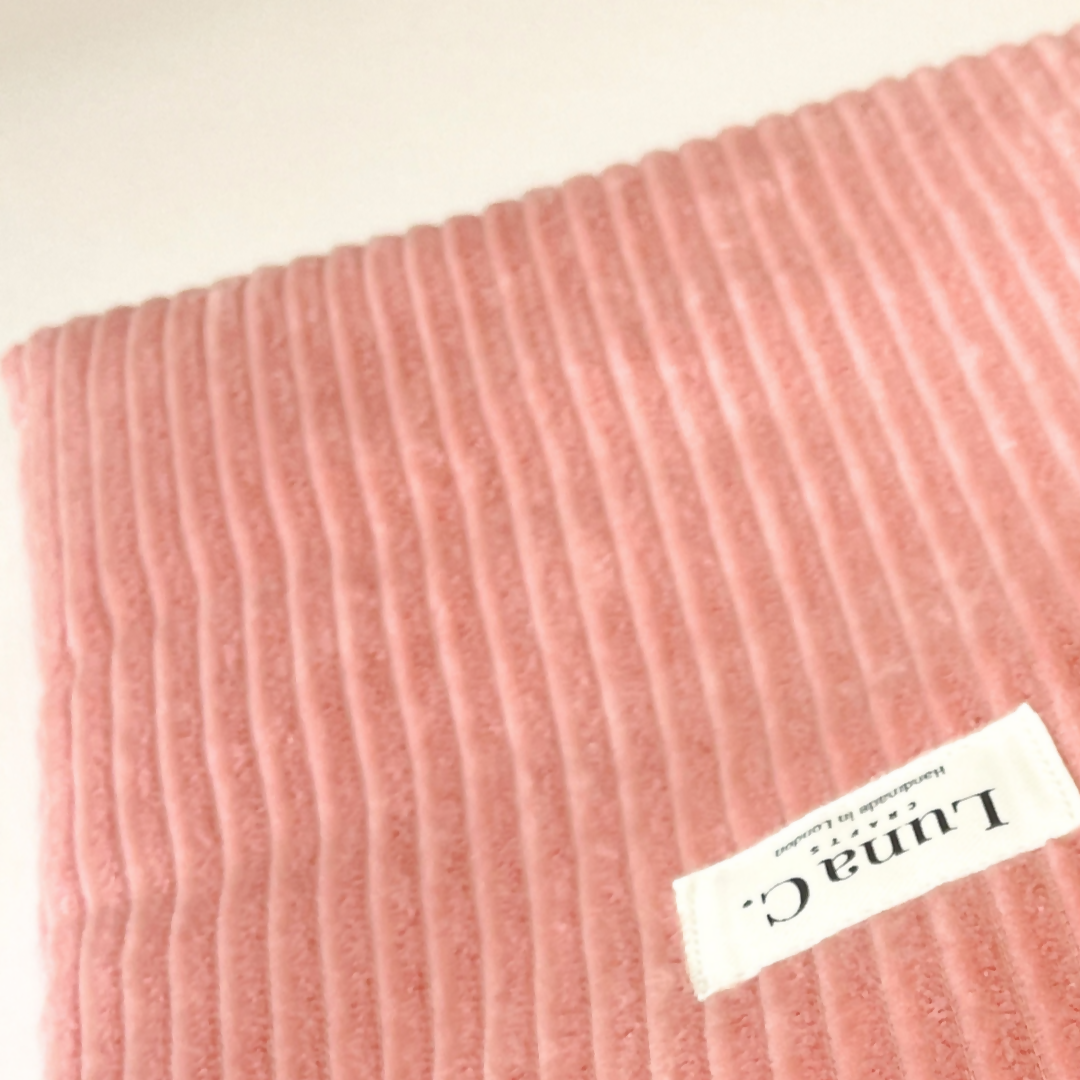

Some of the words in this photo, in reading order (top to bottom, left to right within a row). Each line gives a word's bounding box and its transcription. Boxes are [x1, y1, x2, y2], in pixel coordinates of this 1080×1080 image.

[858, 765, 946, 814] Handmade
[774, 819, 833, 858] London
[809, 800, 918, 856] CRAFTS
[817, 787, 1009, 883] Luna
[837, 811, 854, 824] in
[742, 876, 810, 928] C.
